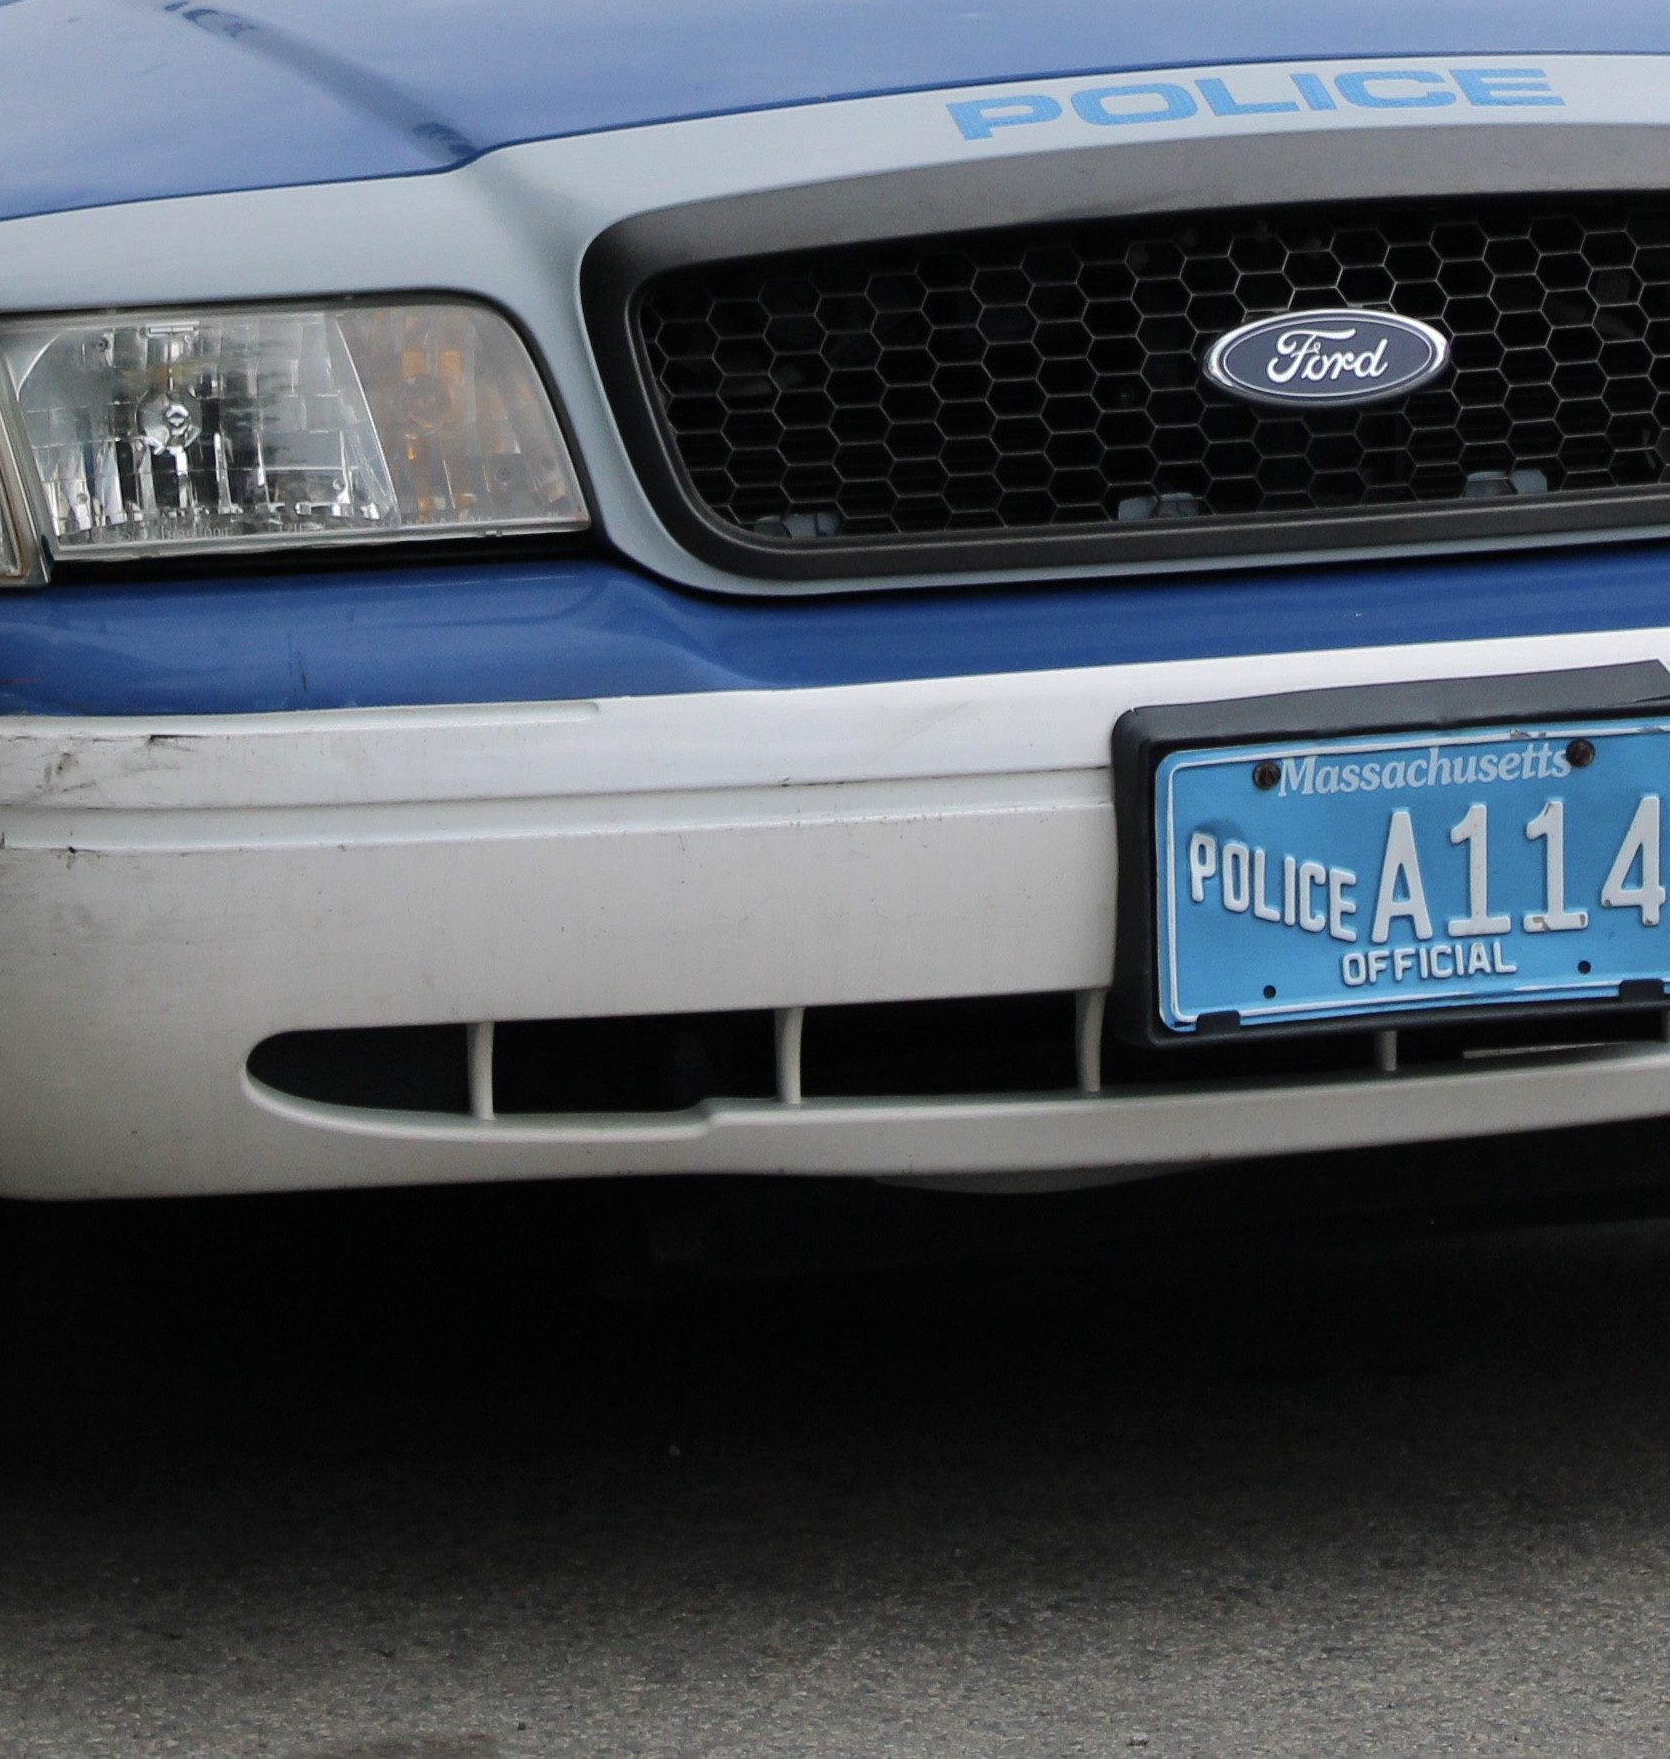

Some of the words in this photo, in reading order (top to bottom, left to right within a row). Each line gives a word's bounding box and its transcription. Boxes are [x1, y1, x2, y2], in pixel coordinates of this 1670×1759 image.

[945, 67, 1565, 141] POLICE
[1266, 327, 1389, 384] Ford
[1277, 741, 1572, 798] Massachusetts
[1188, 830, 1358, 943] POLICE
[1371, 793, 1668, 944] A114
[1340, 939, 1518, 988] OFFICIAL
